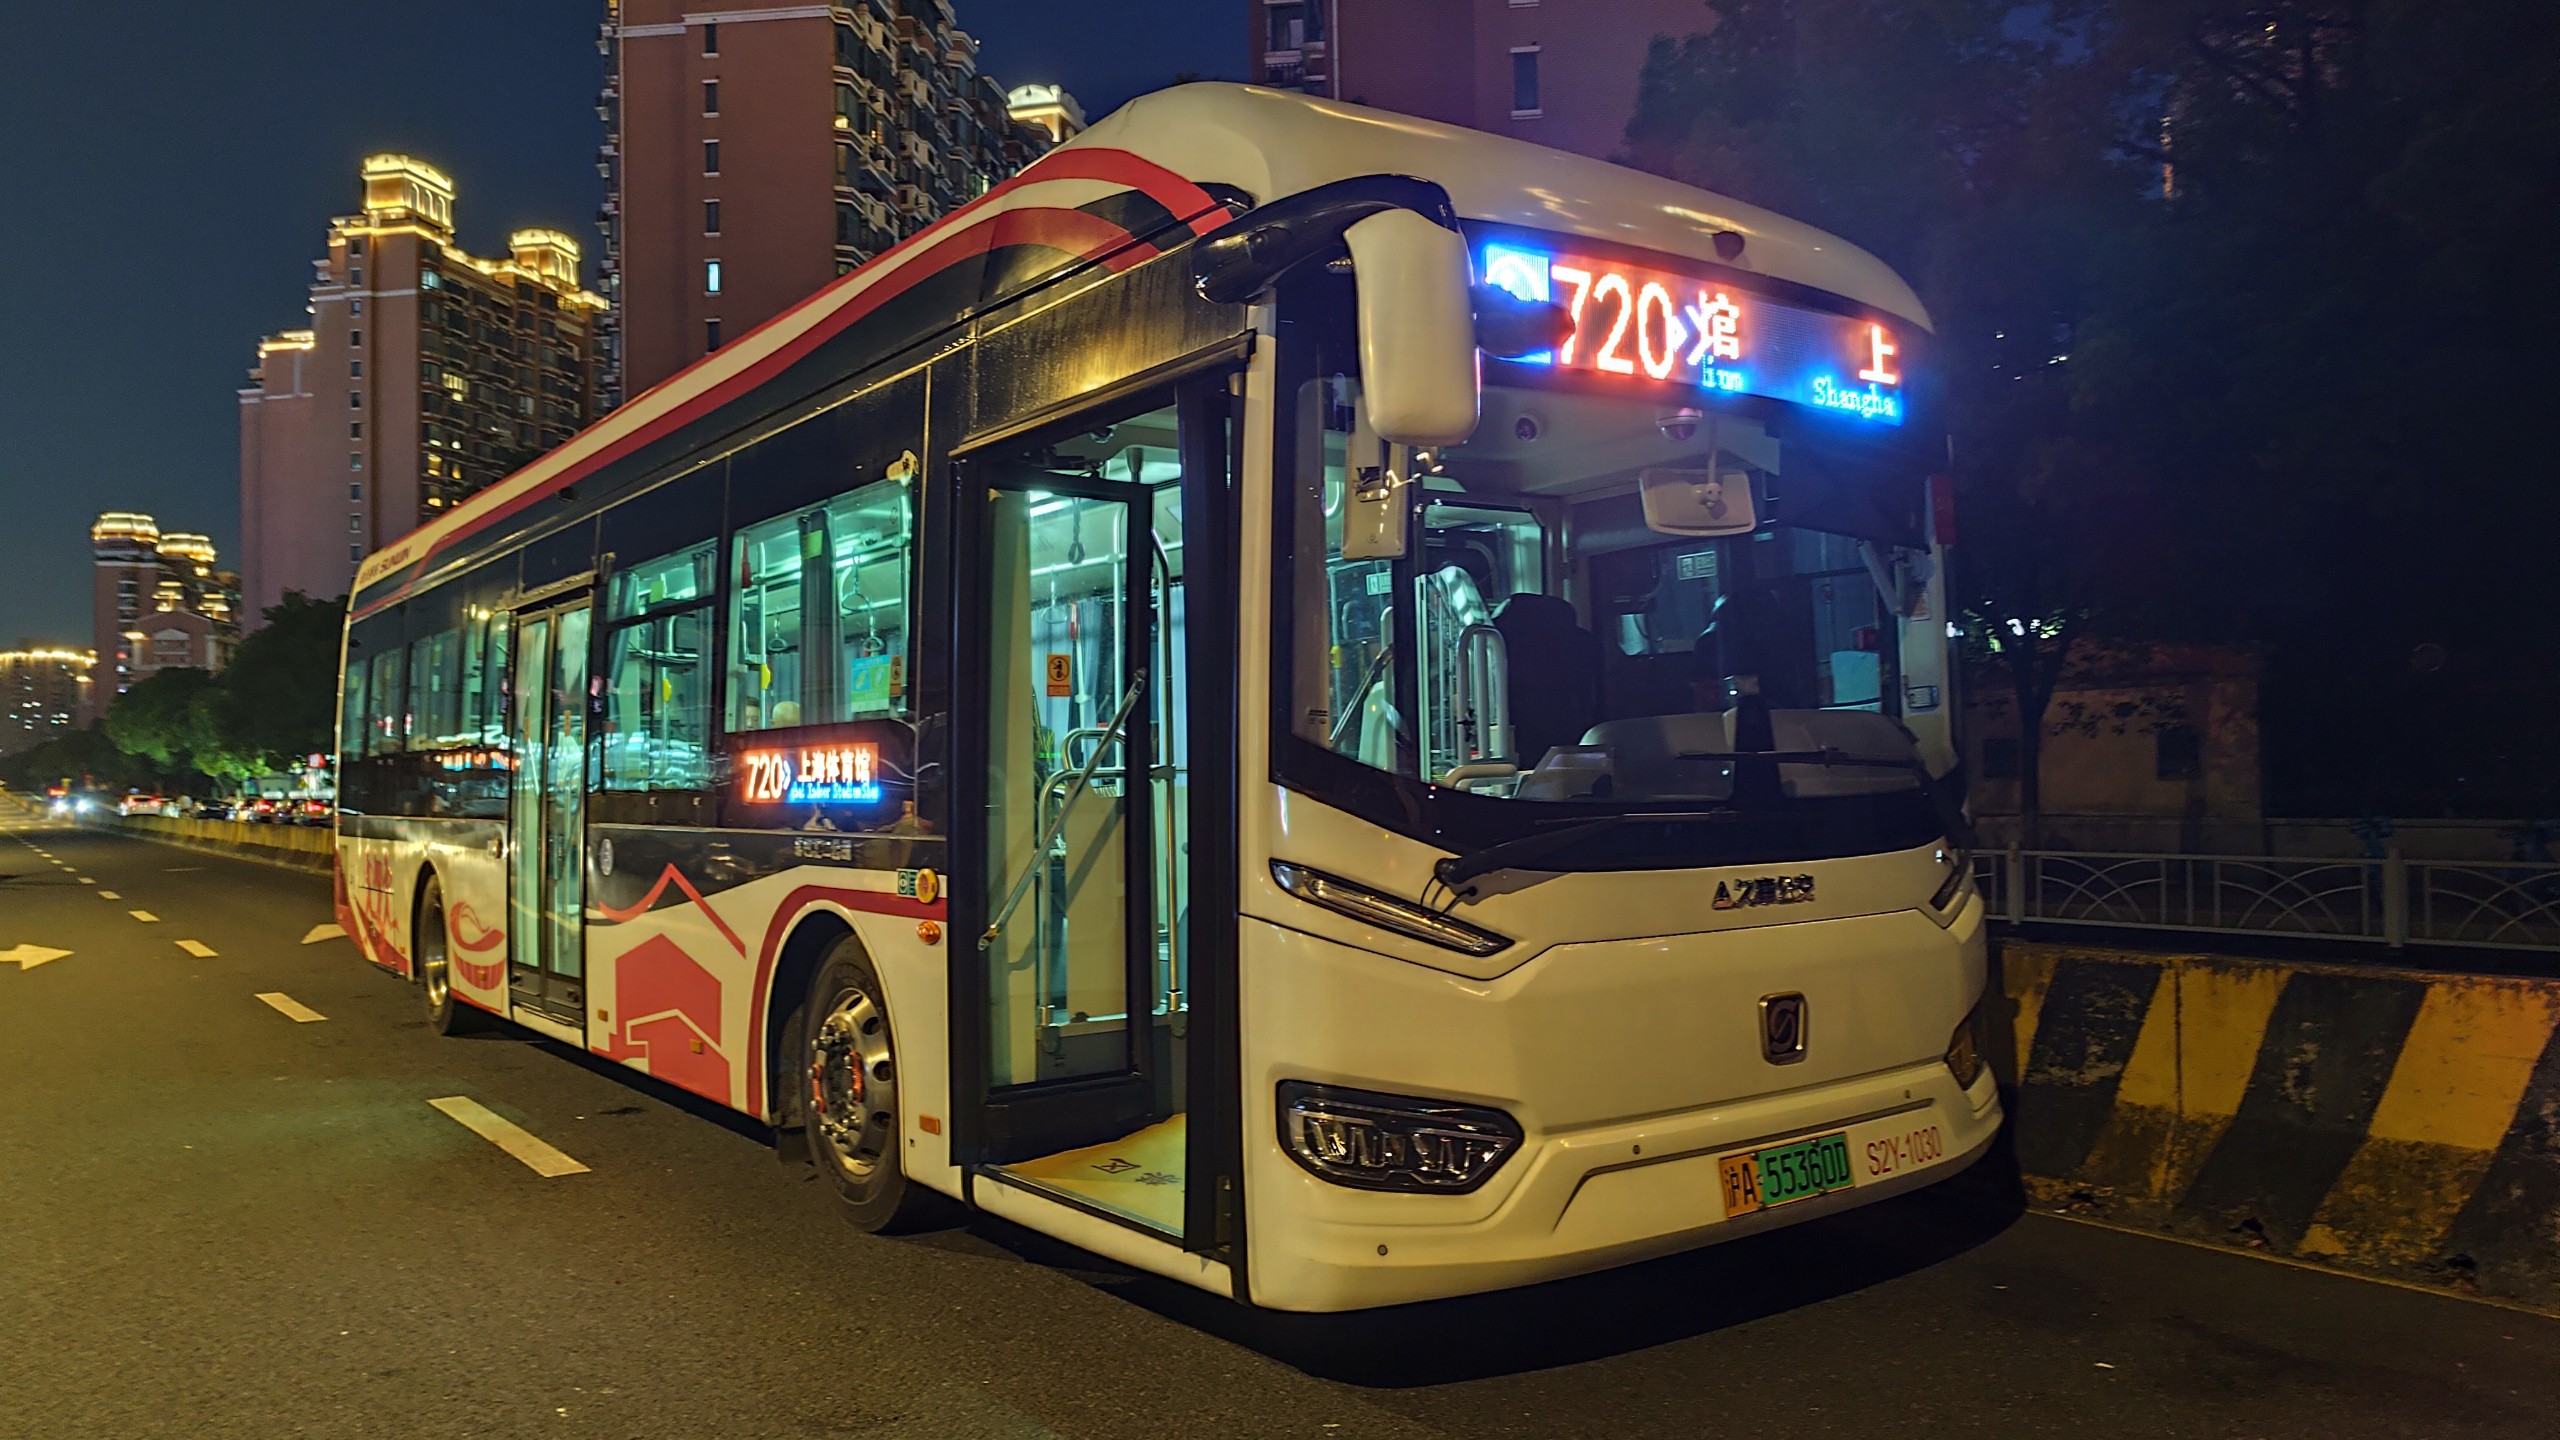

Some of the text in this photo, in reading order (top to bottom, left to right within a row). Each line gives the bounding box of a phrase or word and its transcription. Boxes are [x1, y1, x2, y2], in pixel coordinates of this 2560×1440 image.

[1550, 264, 1674, 380] 720
[1858, 322, 1897, 385] 上
[746, 748, 871, 799] 720 上海体育馆
[1866, 1126, 1943, 1176] S2Y-1030
